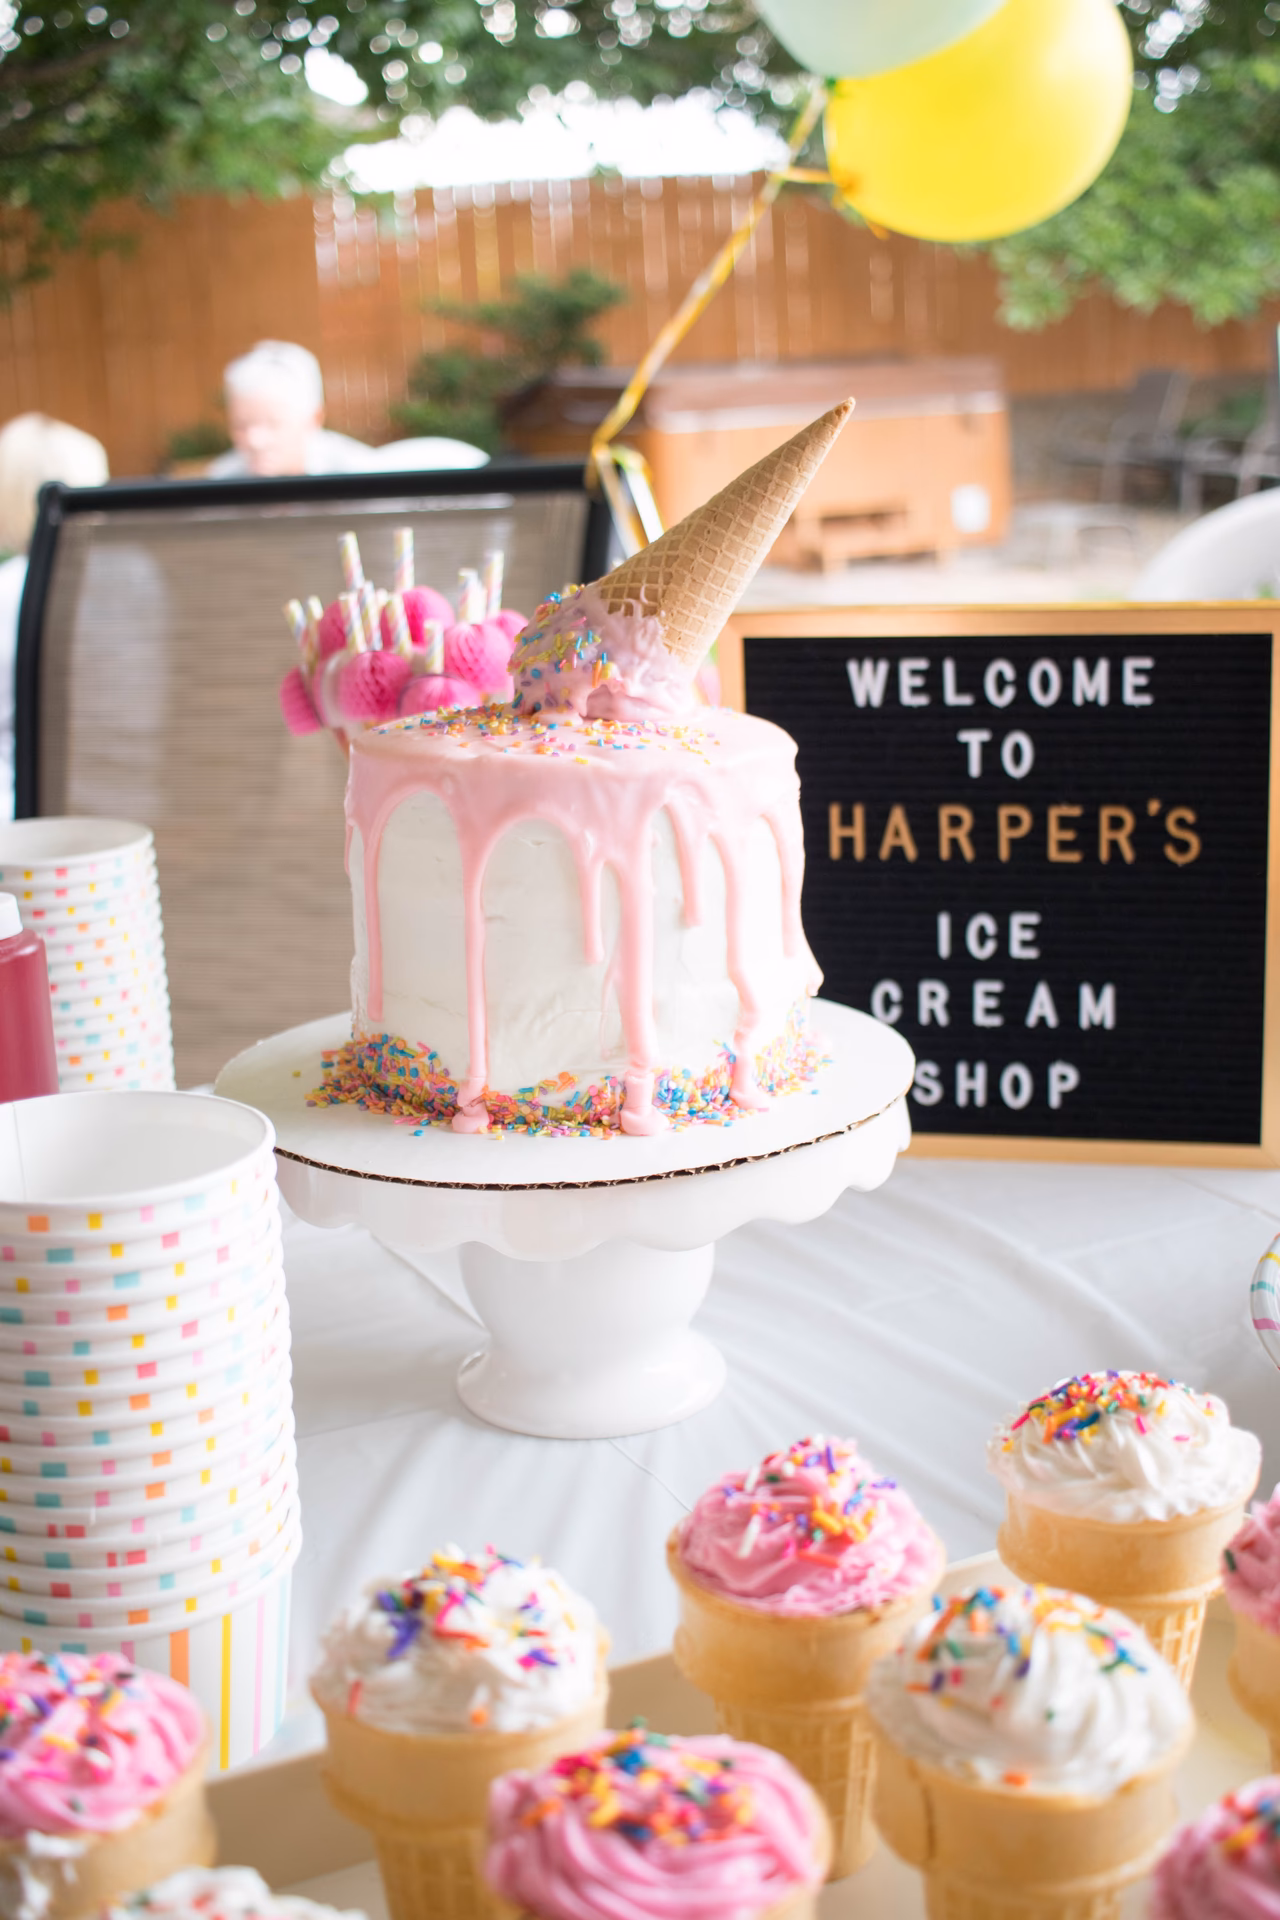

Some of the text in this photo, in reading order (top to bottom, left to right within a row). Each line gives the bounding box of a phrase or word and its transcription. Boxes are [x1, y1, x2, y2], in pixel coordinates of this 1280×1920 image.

[847, 658, 1153, 708] WELCOME
[957, 730, 1033, 778] TO
[830, 800, 1200, 864] HARPER'S
[938, 913, 1040, 959] ICE
[871, 979, 1115, 1030] CREAM
[911, 1060, 1079, 1109] SHOP
